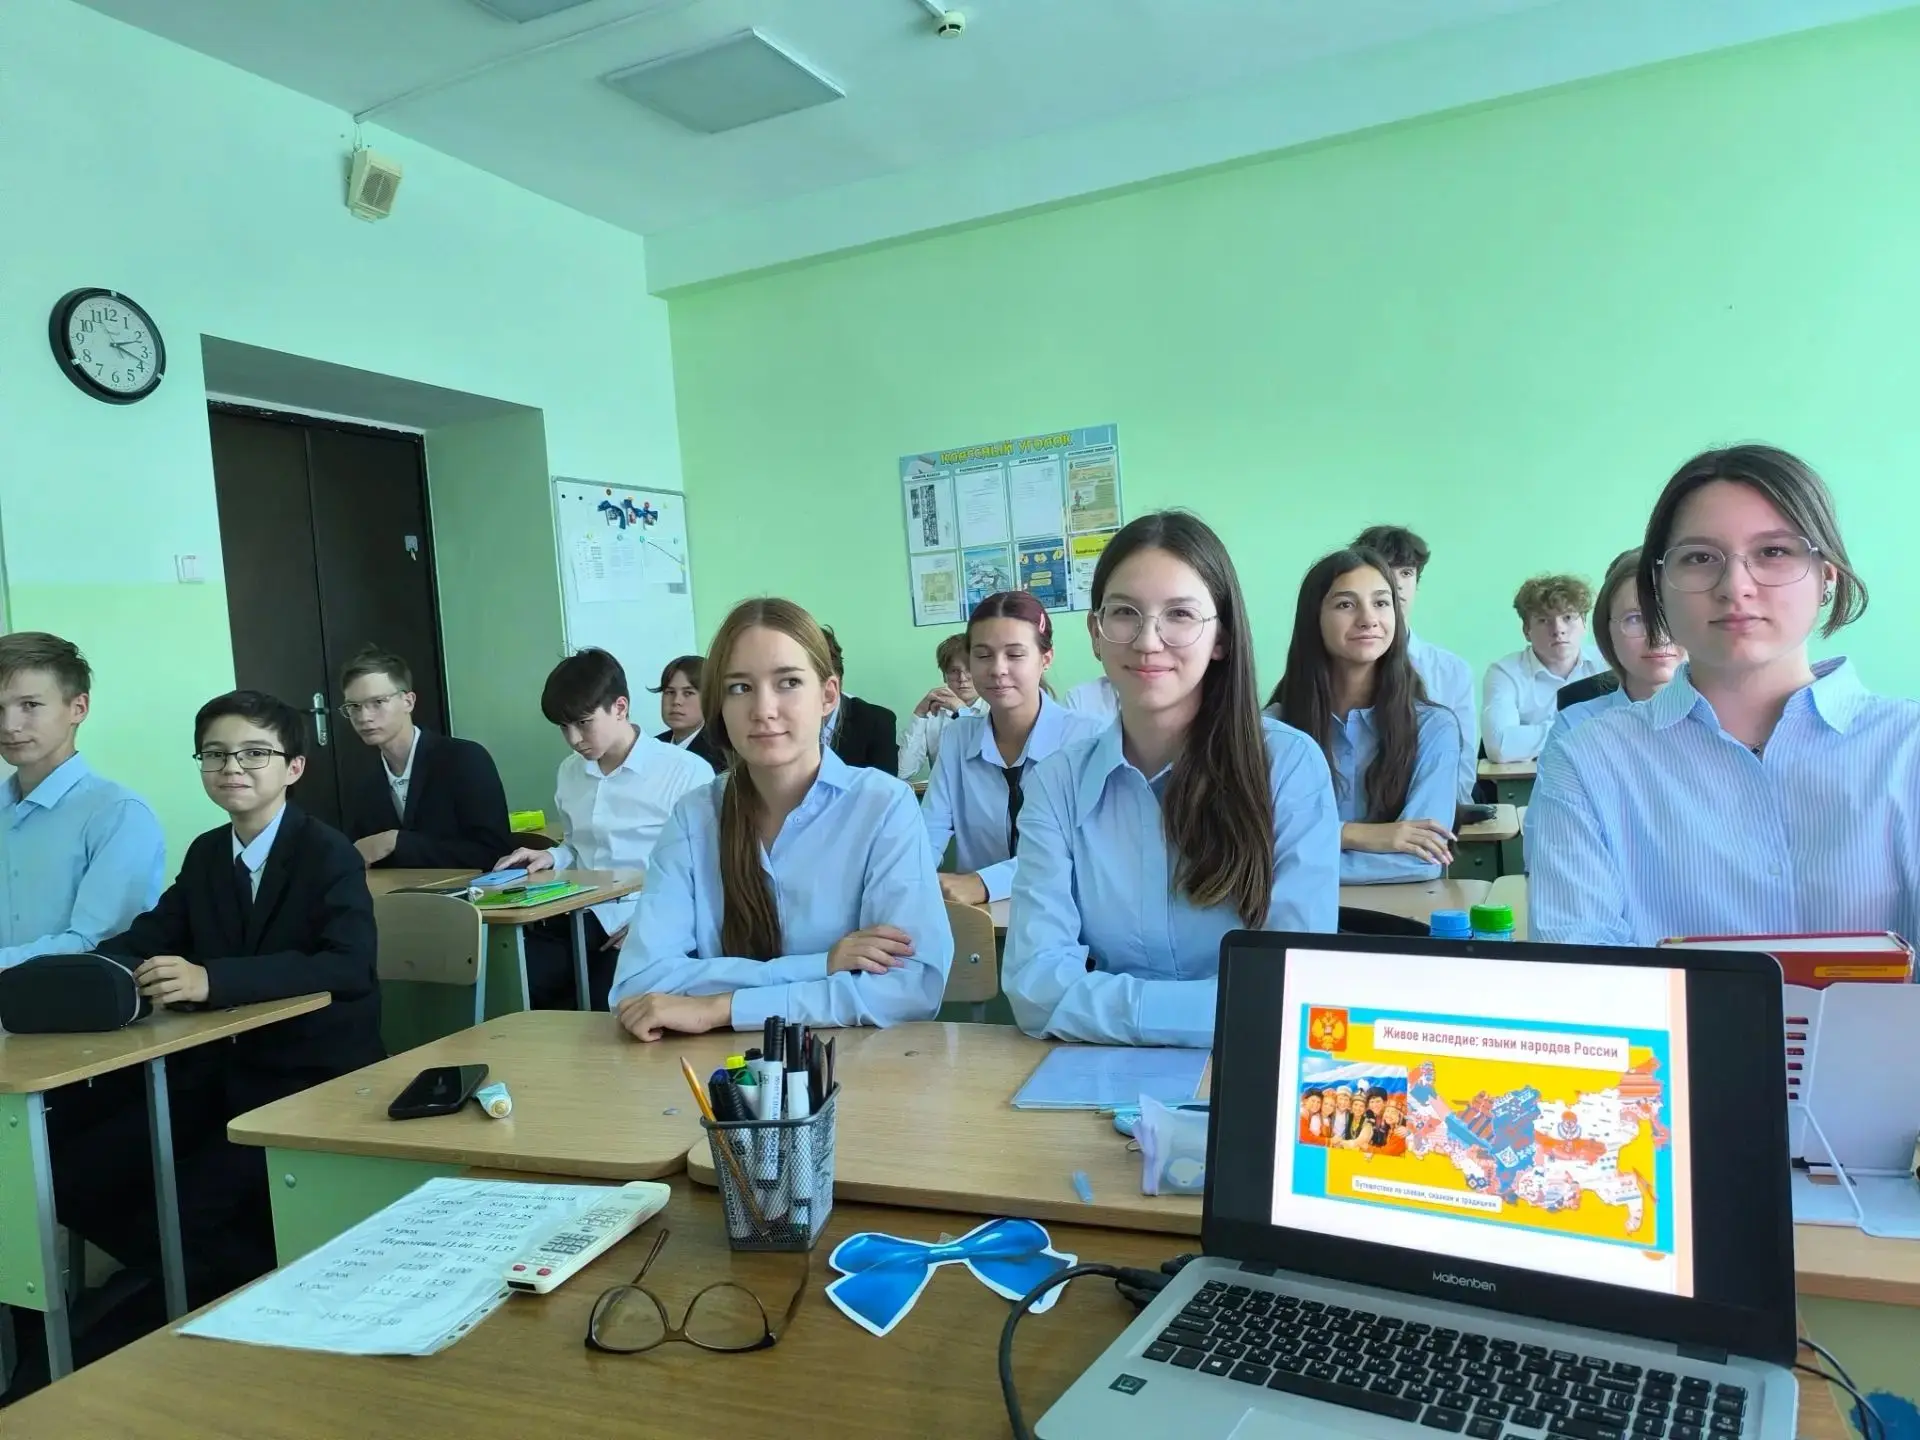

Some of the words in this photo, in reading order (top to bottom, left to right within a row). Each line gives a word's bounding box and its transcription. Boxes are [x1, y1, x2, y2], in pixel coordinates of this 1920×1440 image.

[90, 309, 103, 323] 11
[104, 307, 118, 322] 12
[80, 319, 93, 333] 10
[123, 316, 129, 330] 1
[76, 332, 85, 345] 9
[134, 330, 143, 343] 2
[82, 349, 92, 363] 8
[141, 346, 149, 359] 3
[95, 362, 104, 376] 7
[136, 360, 145, 372] 4
[111, 371, 120, 383] 6
[127, 369, 135, 382] 5
[1383, 1026, 1419, 1041] Живое
[1422, 1031, 1480, 1047] наследие:
[1482, 1037, 1517, 1049] языки
[1520, 1041, 1571, 1055] народов
[1574, 1042, 1618, 1058] России
